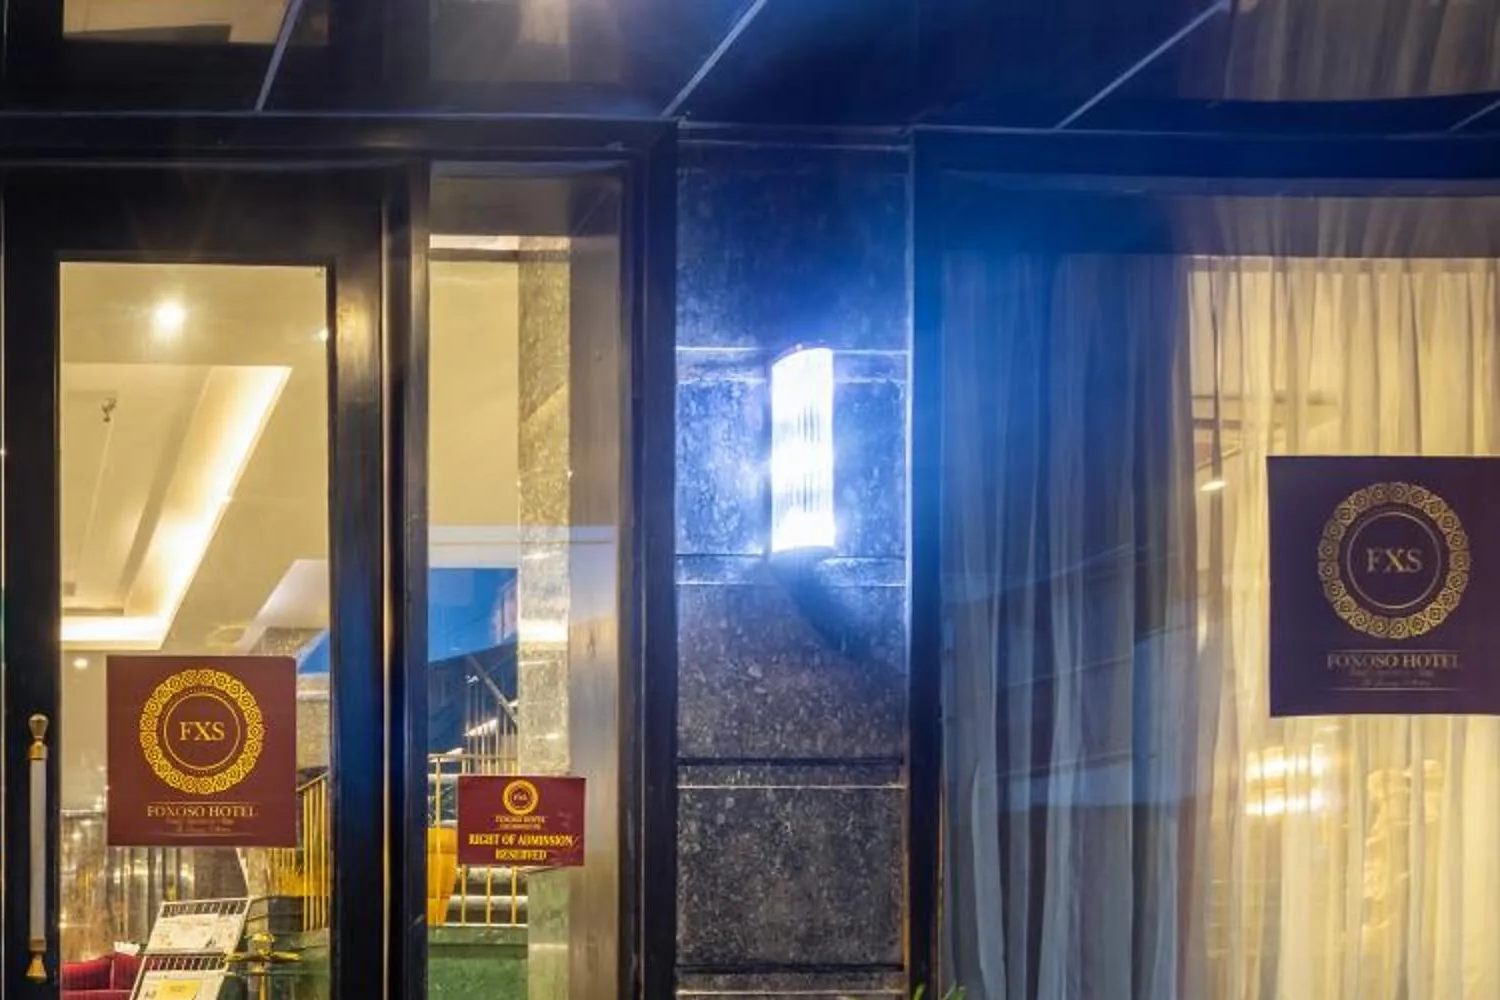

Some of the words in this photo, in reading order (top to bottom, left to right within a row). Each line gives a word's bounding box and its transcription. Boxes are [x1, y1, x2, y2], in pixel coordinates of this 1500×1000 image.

[1366, 548, 1423, 574] FXS
[1403, 653, 1462, 669] HOTEL
[179, 721, 225, 741] FXS
[147, 805, 206, 817] FOXOSO
[209, 805, 258, 817] HOTEL
[468, 833, 499, 845] RIGHT
[501, 833, 517, 845] OF
[518, 833, 573, 846] ADMISSION
